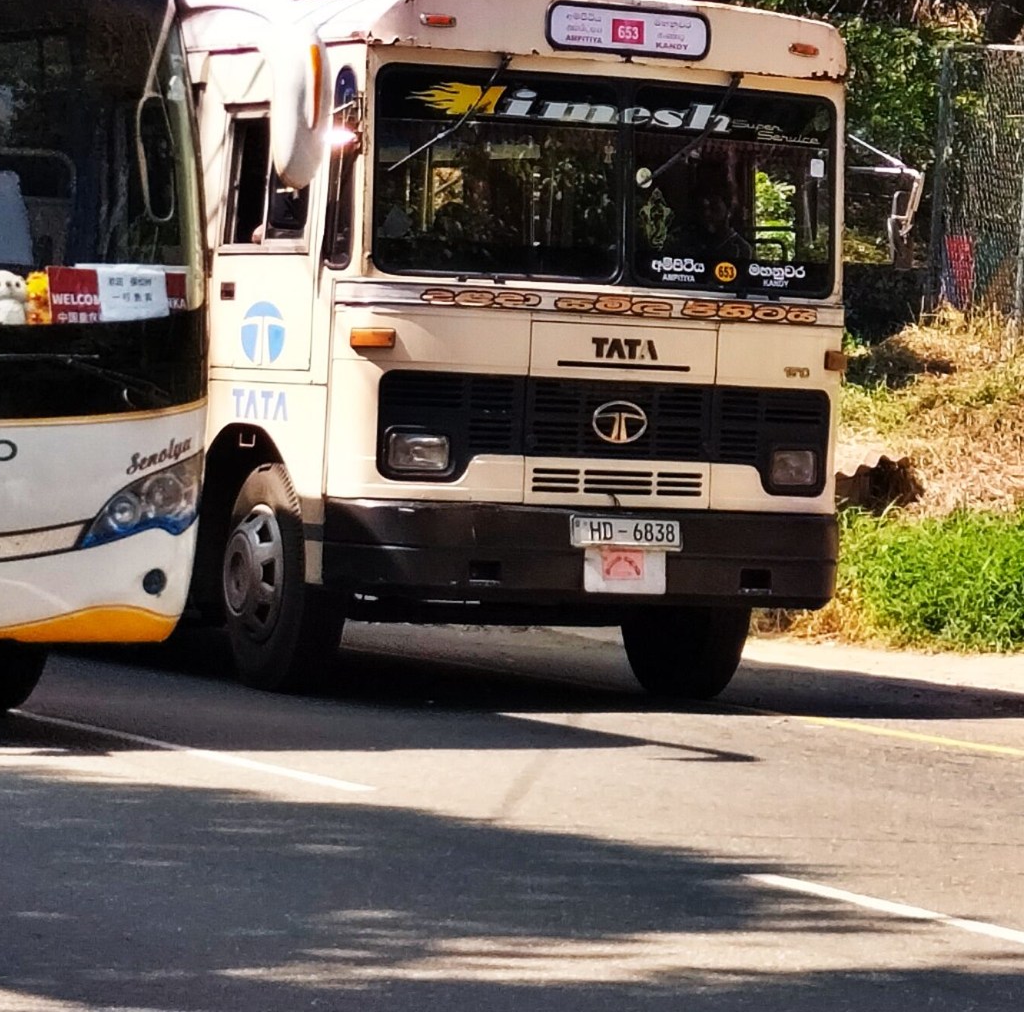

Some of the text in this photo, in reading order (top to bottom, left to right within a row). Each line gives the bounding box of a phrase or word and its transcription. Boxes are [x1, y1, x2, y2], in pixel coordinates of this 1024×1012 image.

[617, 25, 640, 40] 653
[655, 41, 690, 51] KANDY
[732, 119, 784, 133] Super
[756, 130, 822, 145] Service
[718, 265, 735, 278] 653
[748, 263, 806, 281] මහනුවර
[762, 279, 790, 288] KANDY
[592, 337, 659, 361] TATA
[232, 388, 288, 422] TATA
